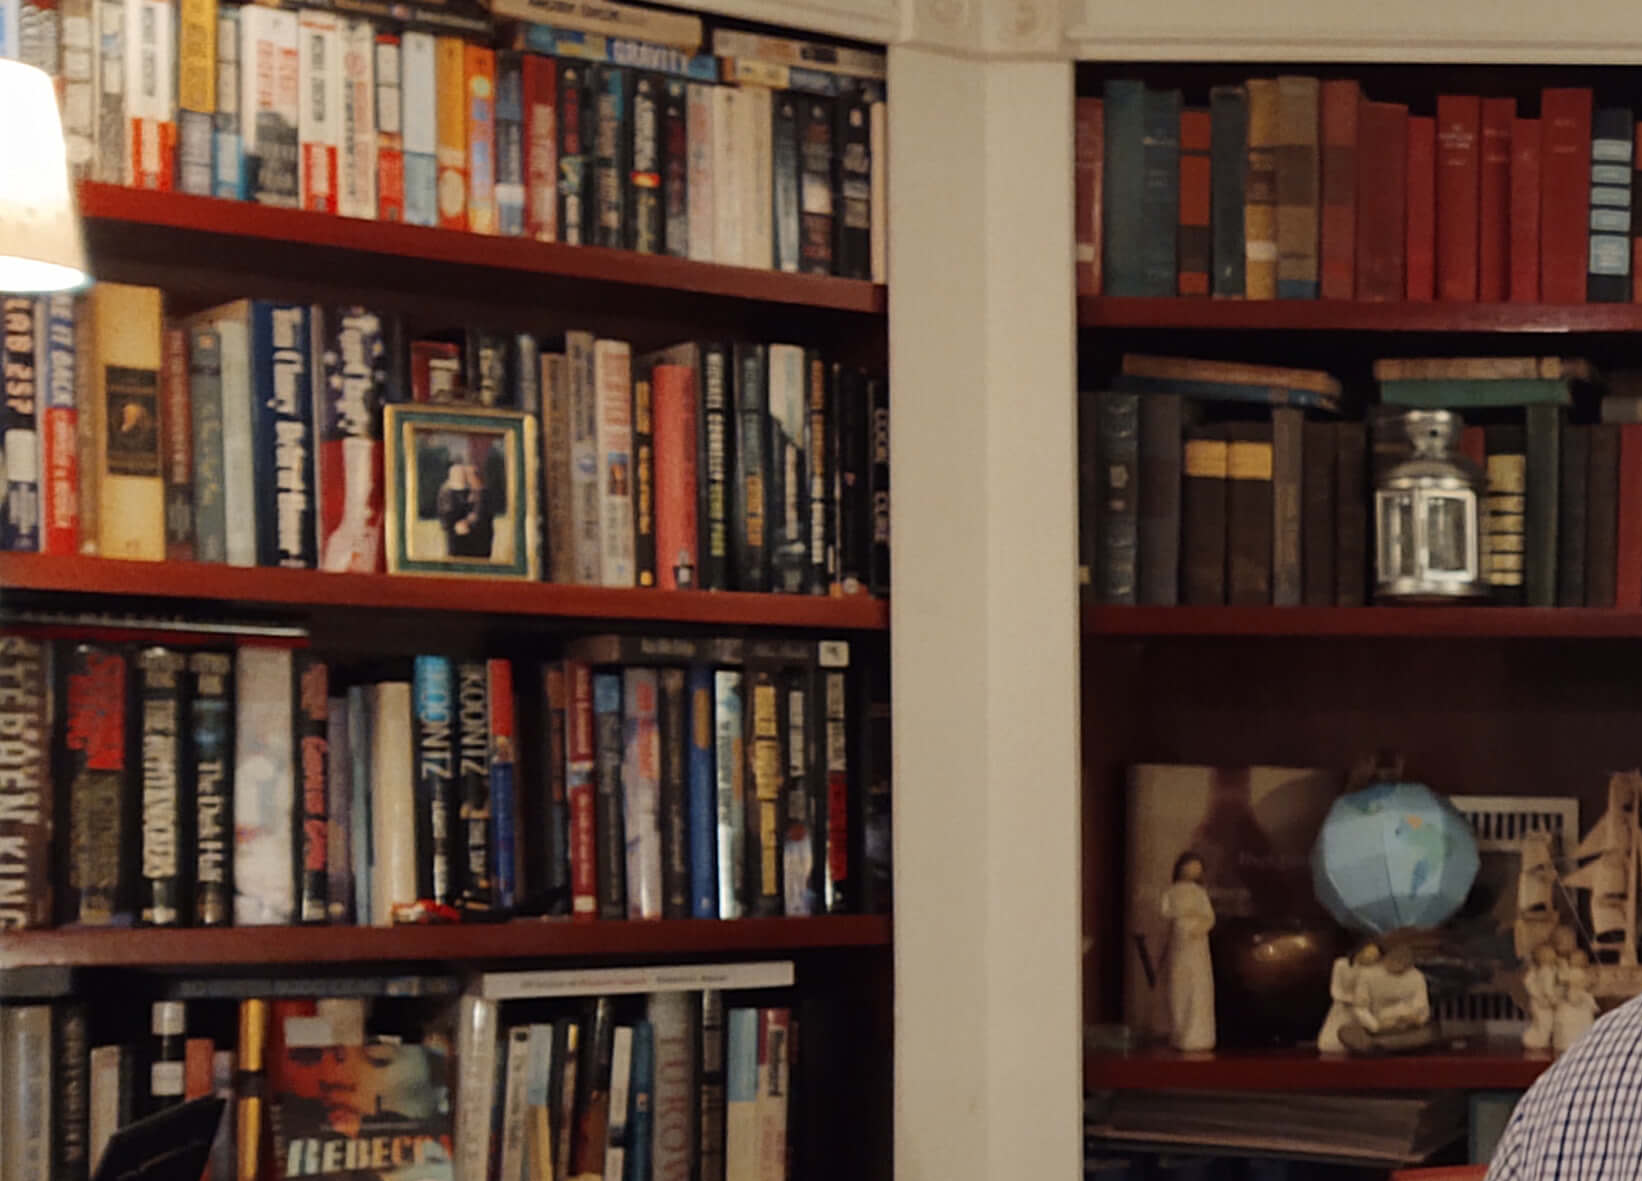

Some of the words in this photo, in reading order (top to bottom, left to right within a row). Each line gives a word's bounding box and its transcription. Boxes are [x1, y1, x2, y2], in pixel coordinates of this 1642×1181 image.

[0, 635, 43, 826] STEPHEN
[420, 664, 453, 780] KOONTZ
[460, 664, 488, 777] KOONTZ
[0, 834, 31, 932] KING
